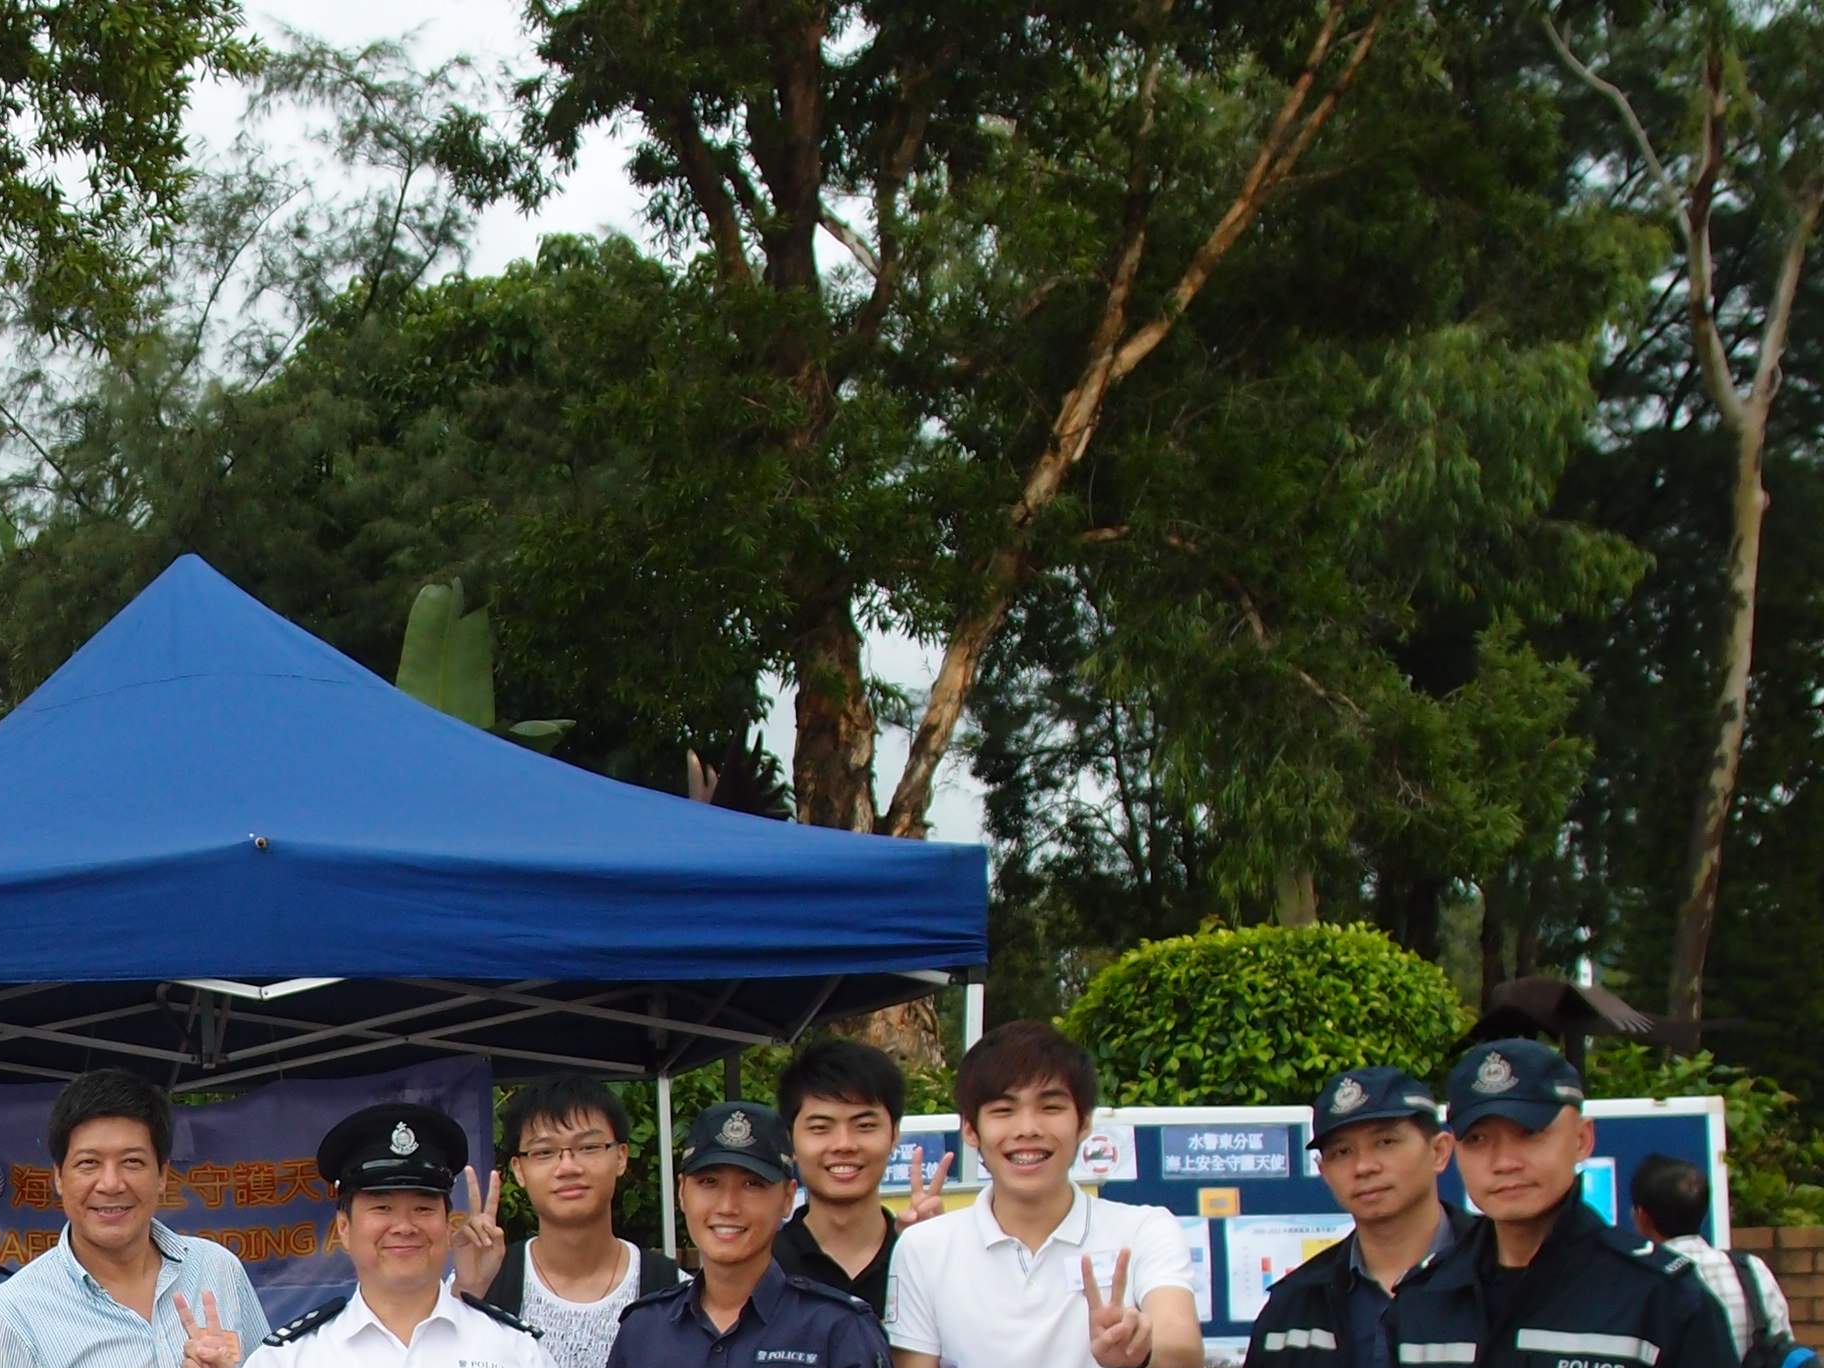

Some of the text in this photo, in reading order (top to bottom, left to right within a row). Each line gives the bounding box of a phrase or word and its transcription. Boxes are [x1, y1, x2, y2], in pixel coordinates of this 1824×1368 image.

[1188, 1132, 1264, 1151] 水警東分區
[1165, 1154, 1286, 1172] 海上安全守護天使
[768, 1350, 805, 1361] POLICE
